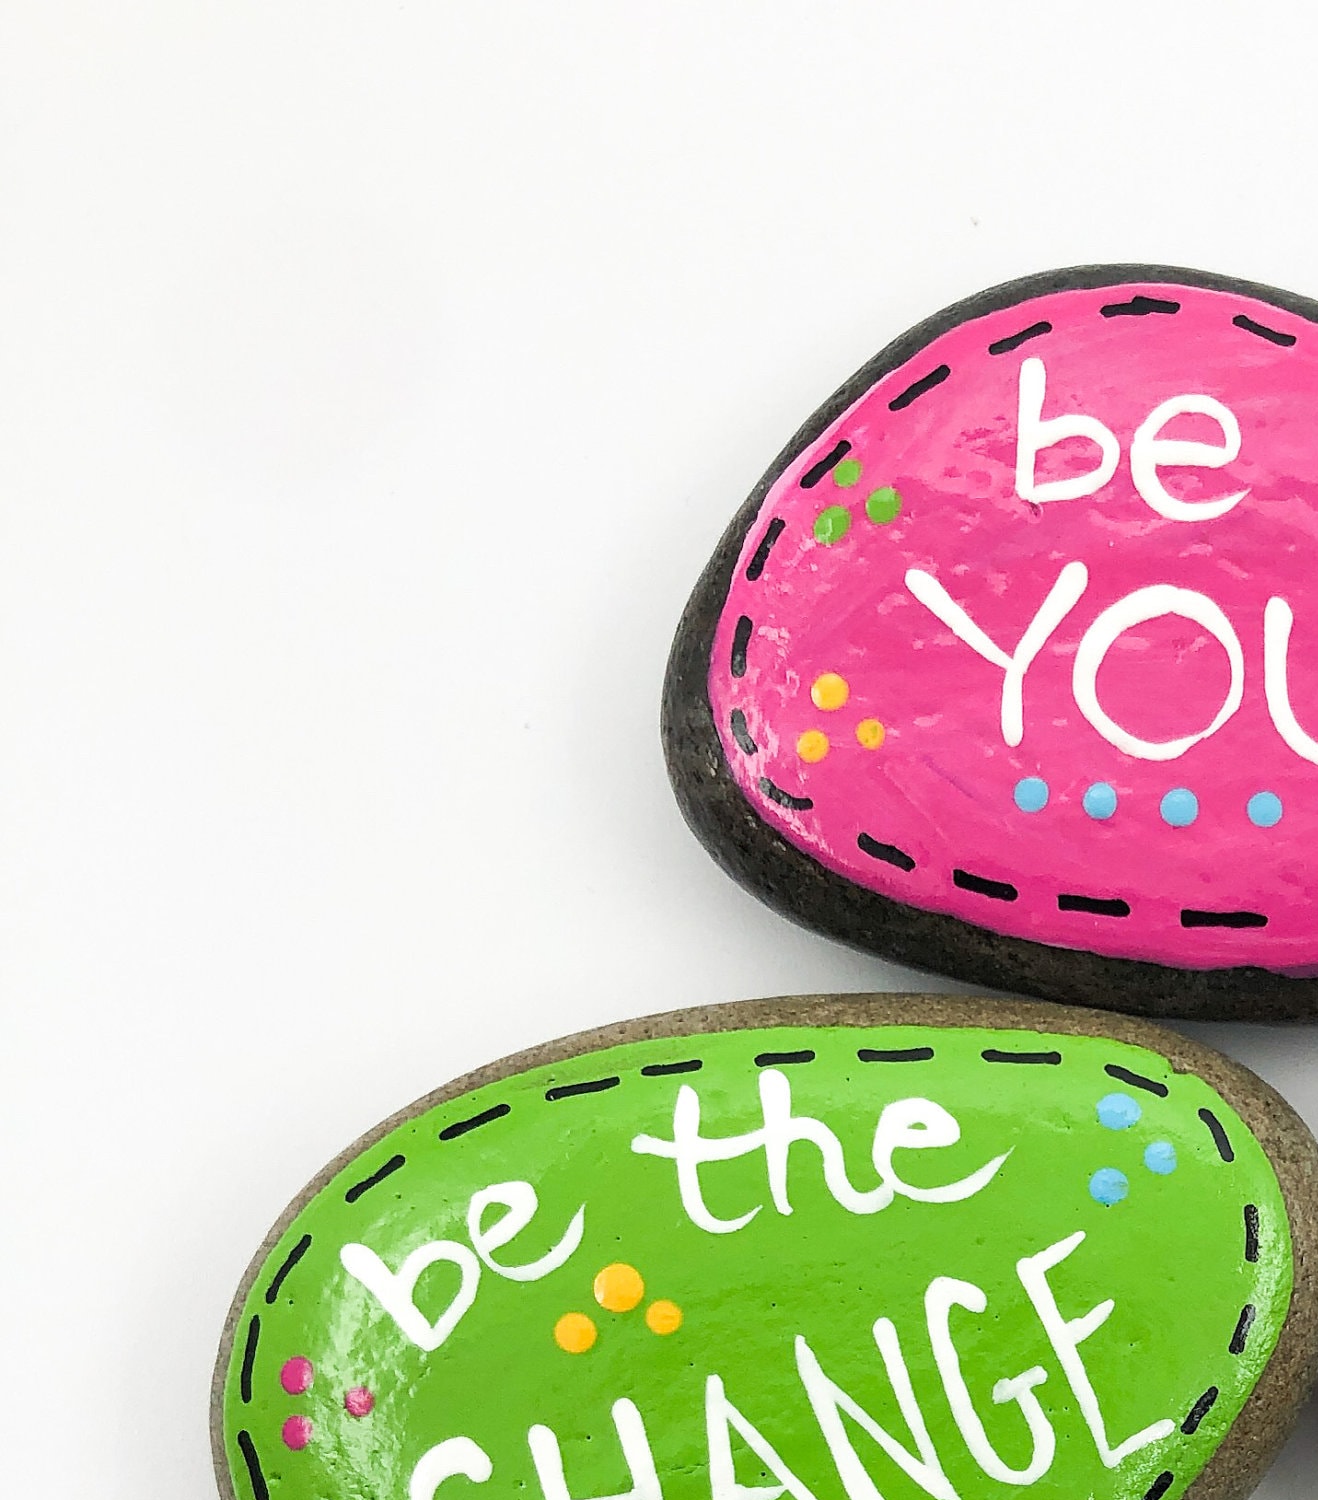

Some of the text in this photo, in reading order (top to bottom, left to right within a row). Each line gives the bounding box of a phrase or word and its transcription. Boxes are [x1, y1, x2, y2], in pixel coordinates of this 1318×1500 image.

[1015, 356, 1253, 523] be
[340, 1068, 1015, 1352] be the
